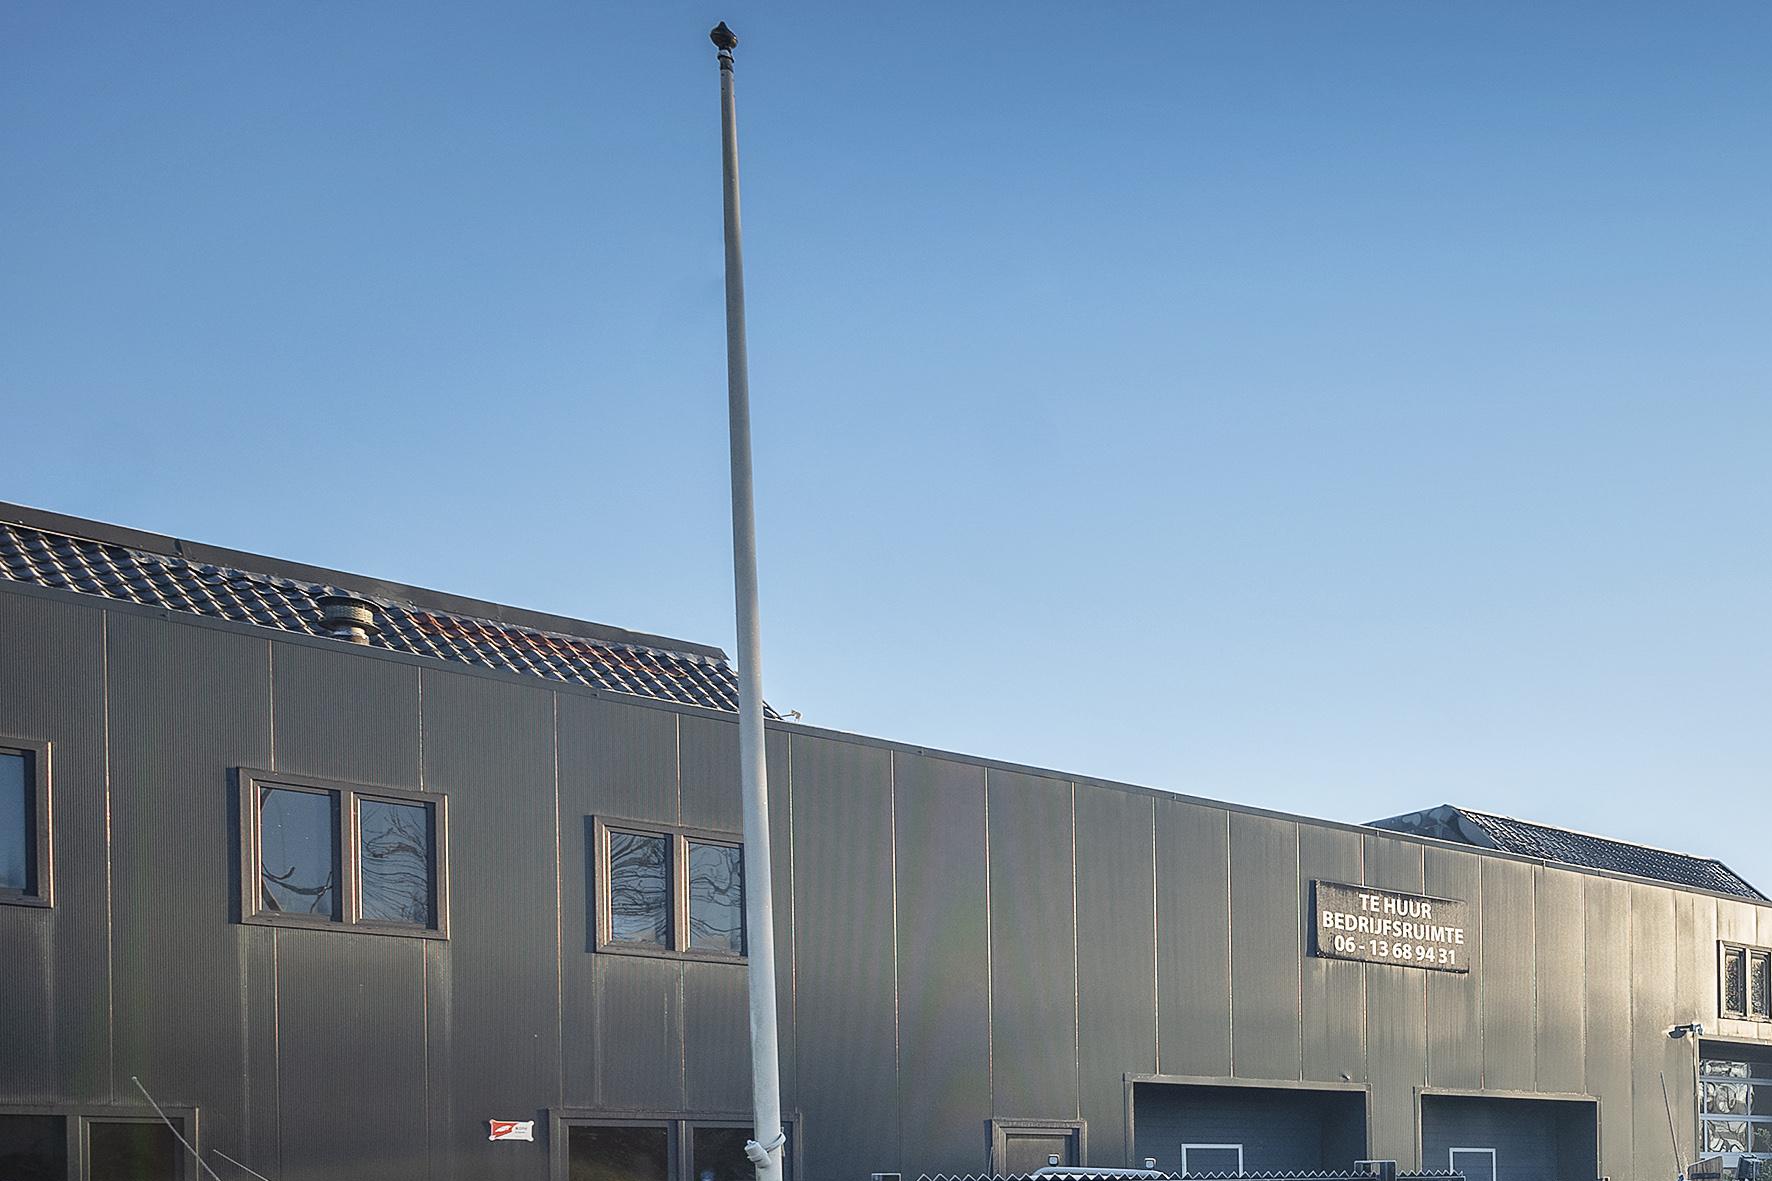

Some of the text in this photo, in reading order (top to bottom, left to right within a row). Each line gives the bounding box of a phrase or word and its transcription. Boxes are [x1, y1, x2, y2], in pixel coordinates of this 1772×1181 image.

[1358, 893, 1432, 919] TE HUUR
[1322, 910, 1464, 945] BEDRIJFSRUIMTE
[1334, 934, 1356, 953] 06
[1370, 939, 1389, 957] 13
[1392, 943, 1412, 960] 68
[1416, 946, 1435, 963] 94
[1438, 949, 1456, 965] 31
